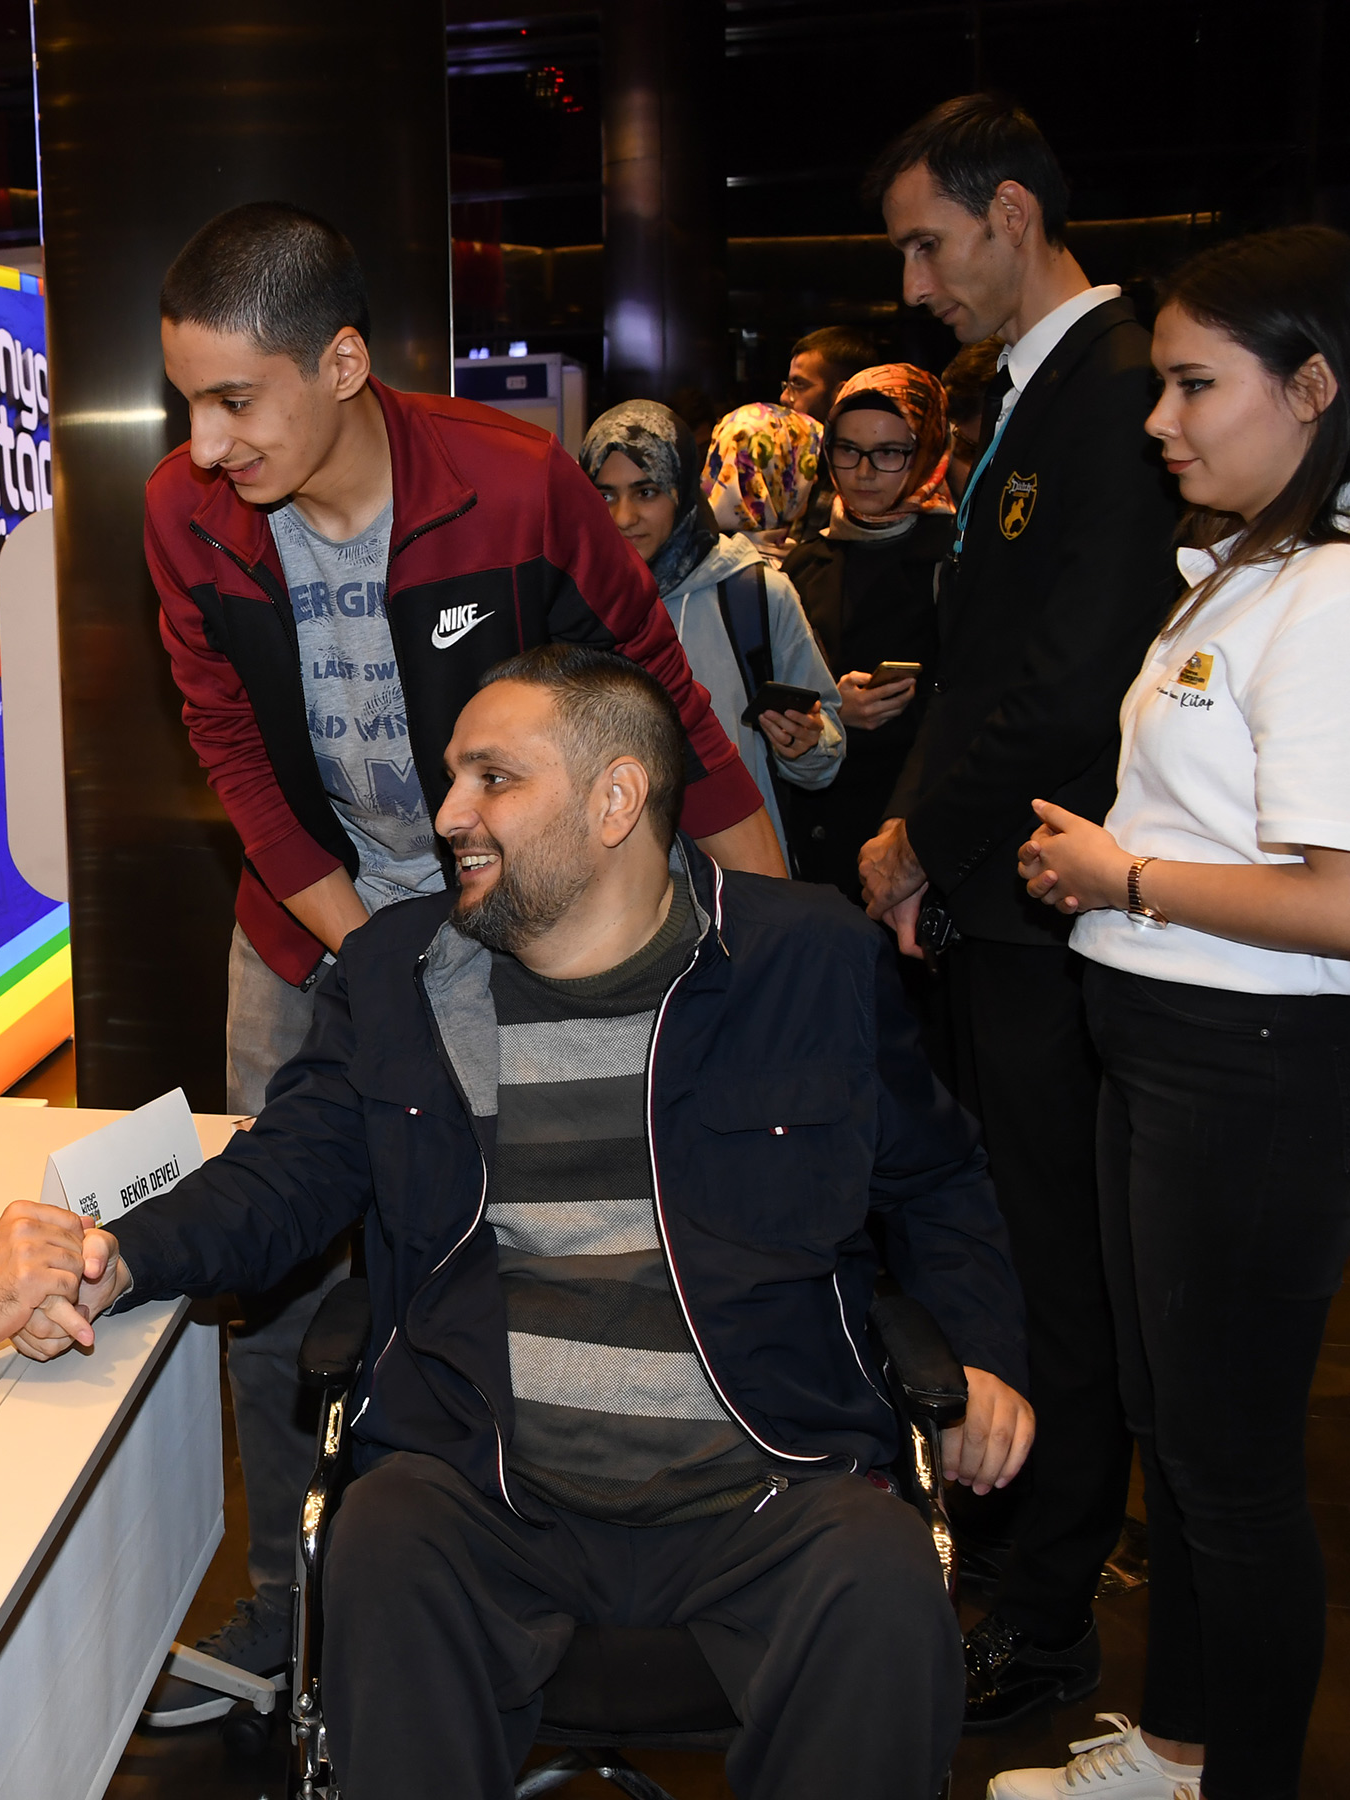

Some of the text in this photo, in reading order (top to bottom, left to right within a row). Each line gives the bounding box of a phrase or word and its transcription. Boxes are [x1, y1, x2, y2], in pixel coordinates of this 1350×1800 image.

[439, 602, 479, 633] NIKE
[1180, 692, 1214, 711] Kitap
[120, 1154, 181, 1209] BEKİR DEVELİ
